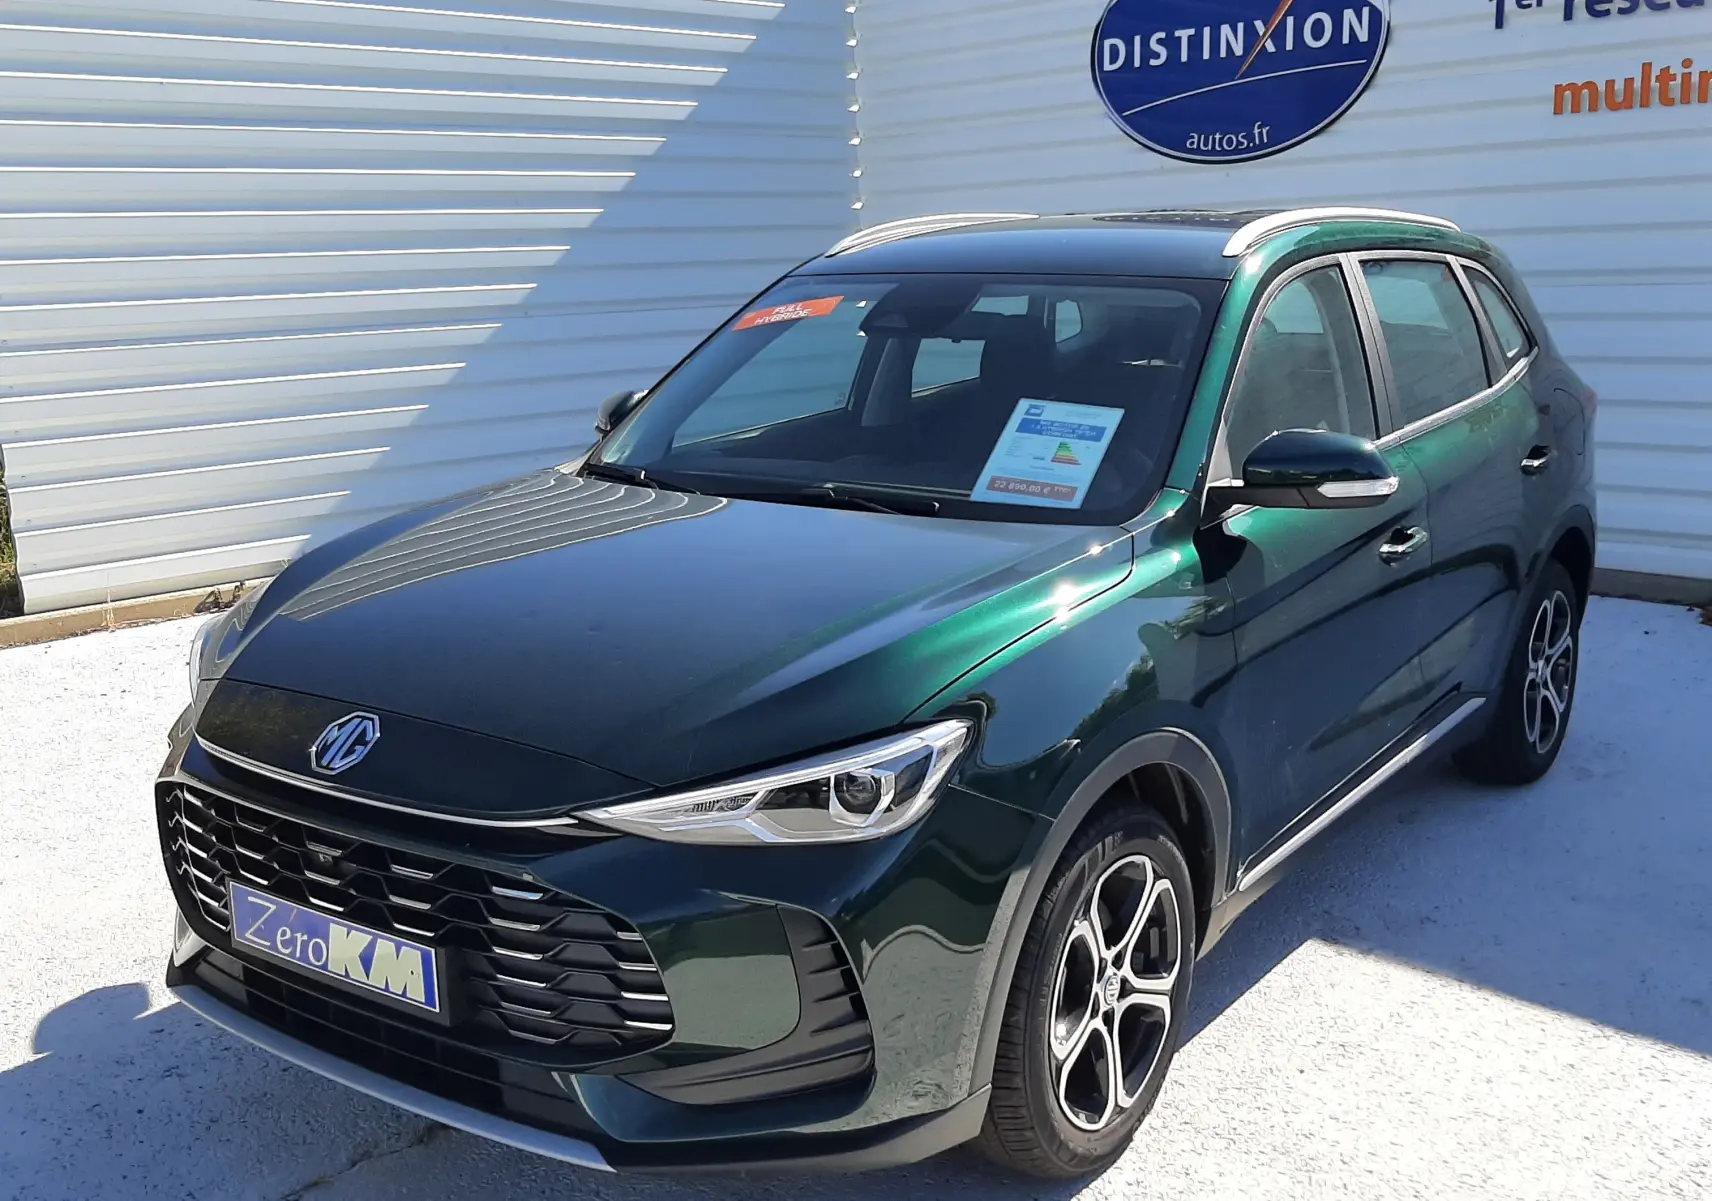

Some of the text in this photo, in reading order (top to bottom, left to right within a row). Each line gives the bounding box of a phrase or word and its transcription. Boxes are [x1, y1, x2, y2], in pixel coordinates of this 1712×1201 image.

[1103, 6, 1370, 71] DISTINXION
[1186, 121, 1270, 151] autos.fr
[754, 308, 812, 326] HYBRIDE
[772, 303, 803, 314] FULL
[317, 717, 374, 769] MG
